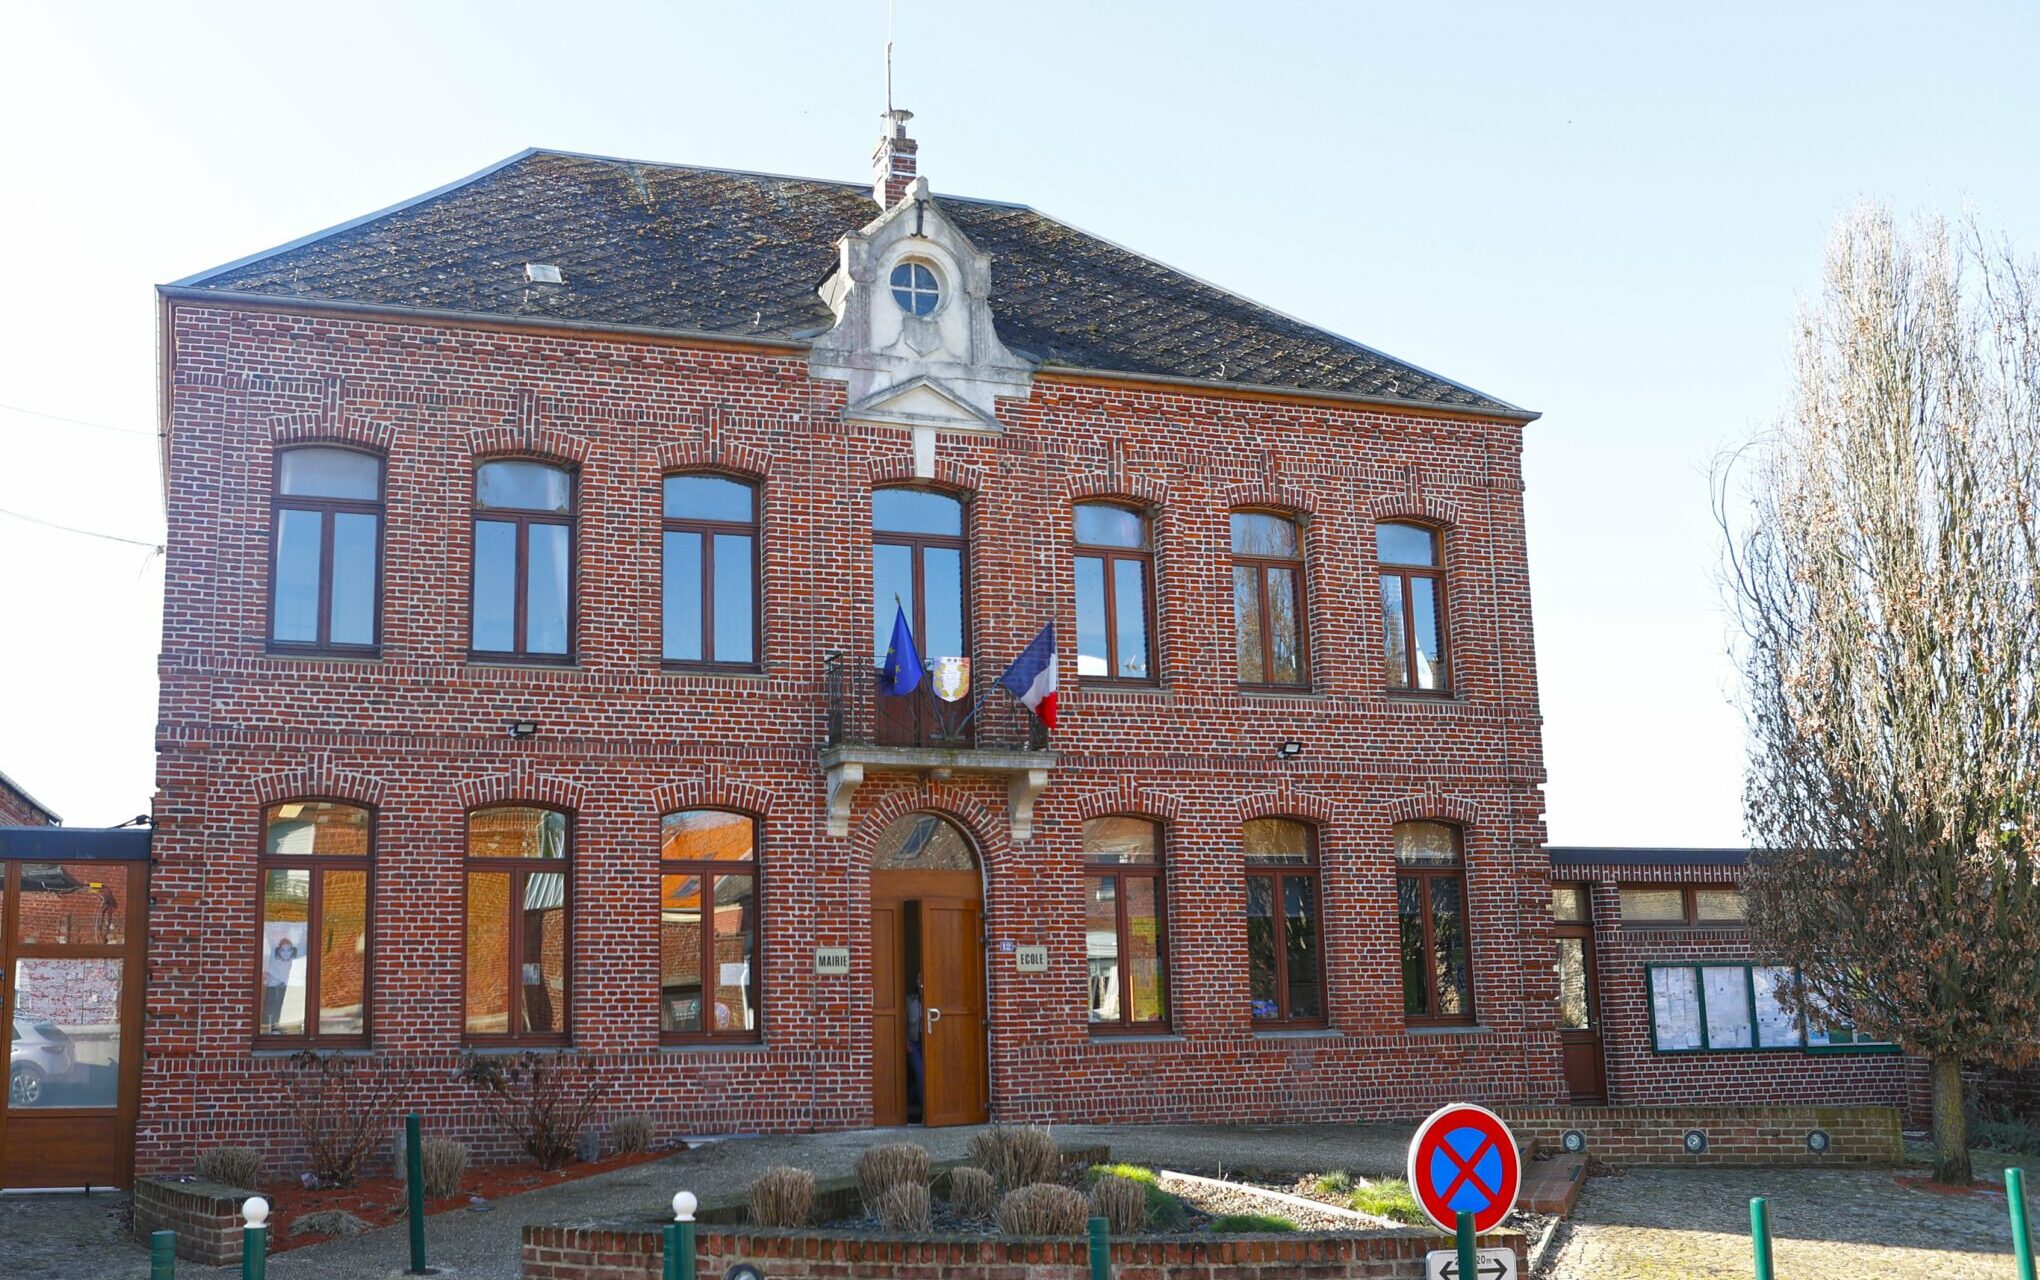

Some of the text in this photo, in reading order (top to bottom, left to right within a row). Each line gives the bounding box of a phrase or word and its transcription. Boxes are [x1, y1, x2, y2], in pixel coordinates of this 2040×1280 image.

[1002, 943, 1012, 951] 12
[818, 955, 847, 967] MAIRIE
[1020, 953, 1043, 965] ECOLE
